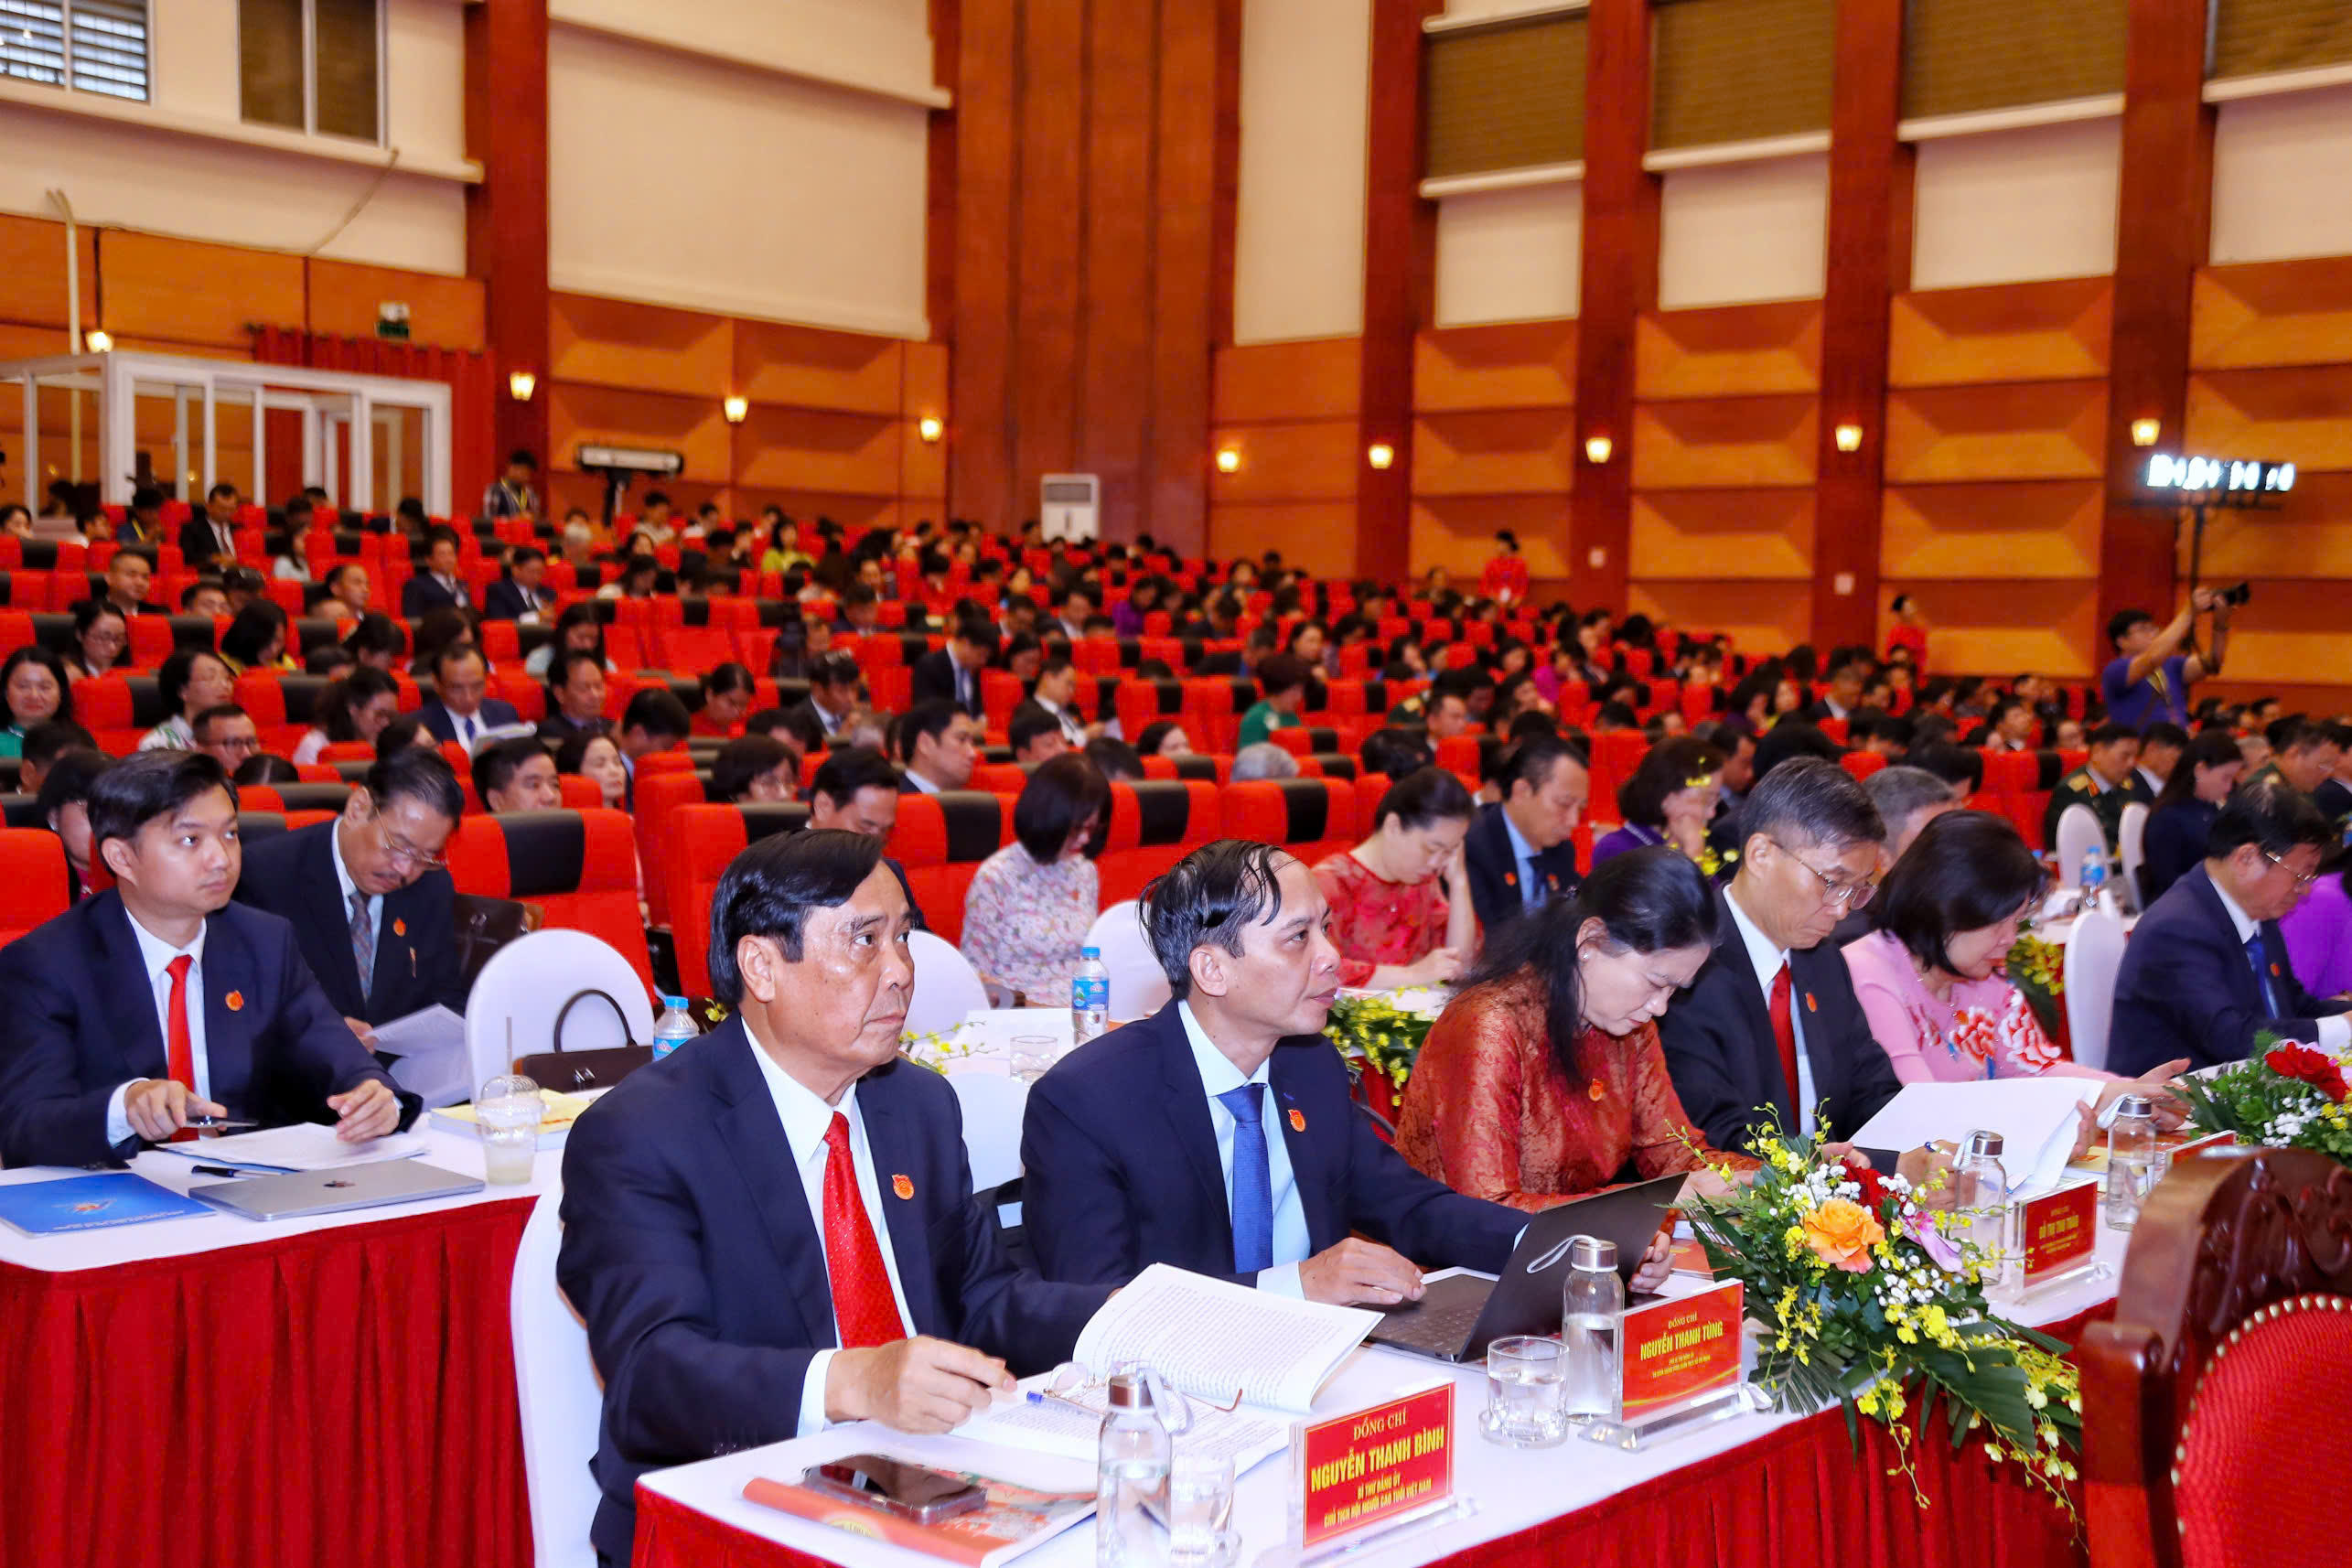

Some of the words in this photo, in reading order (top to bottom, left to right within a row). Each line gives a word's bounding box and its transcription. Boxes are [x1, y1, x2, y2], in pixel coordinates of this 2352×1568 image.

[1640, 1332, 1673, 1361] NGUYỄN
[1675, 1326, 1701, 1350] THANH
[1702, 1320, 1724, 1341] TÙNG
[1353, 1416, 1384, 1441] ĐỒNG
[1387, 1407, 1407, 1428] CHÍ
[1311, 1448, 1365, 1493] NGUYỄN
[1369, 1436, 1411, 1470] THANH
[1414, 1426, 1444, 1457] BÌNH
